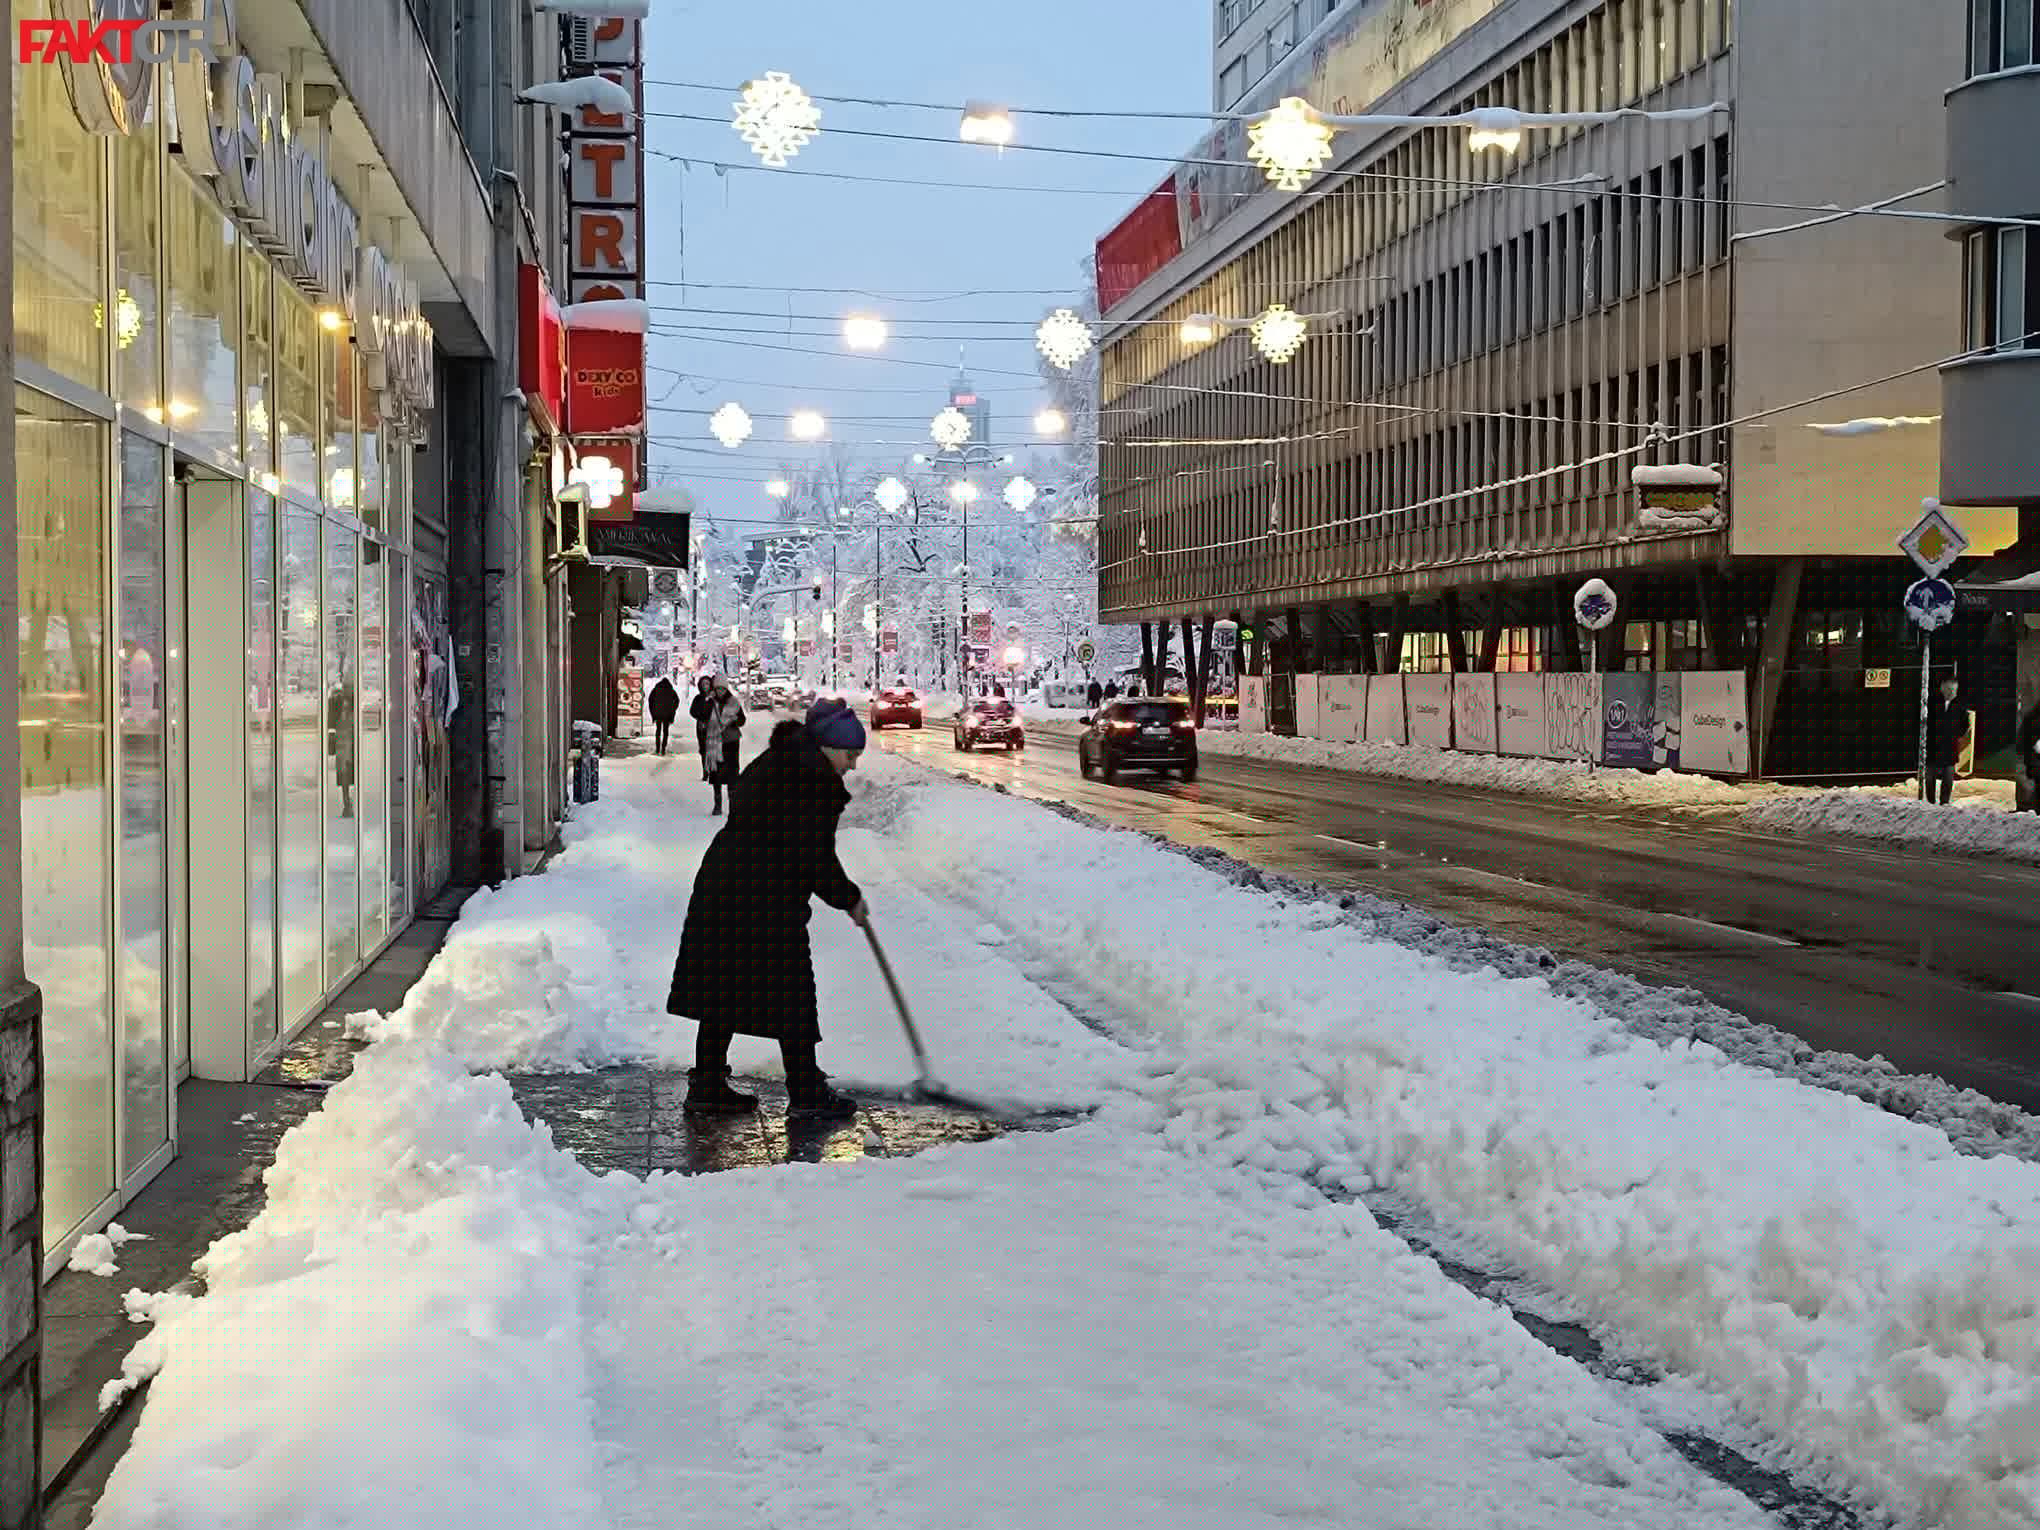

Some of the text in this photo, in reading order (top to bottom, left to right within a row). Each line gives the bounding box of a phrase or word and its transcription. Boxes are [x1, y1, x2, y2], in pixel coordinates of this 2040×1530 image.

[577, 371, 636, 383] DEXY CO
[593, 387, 620, 397] kids
